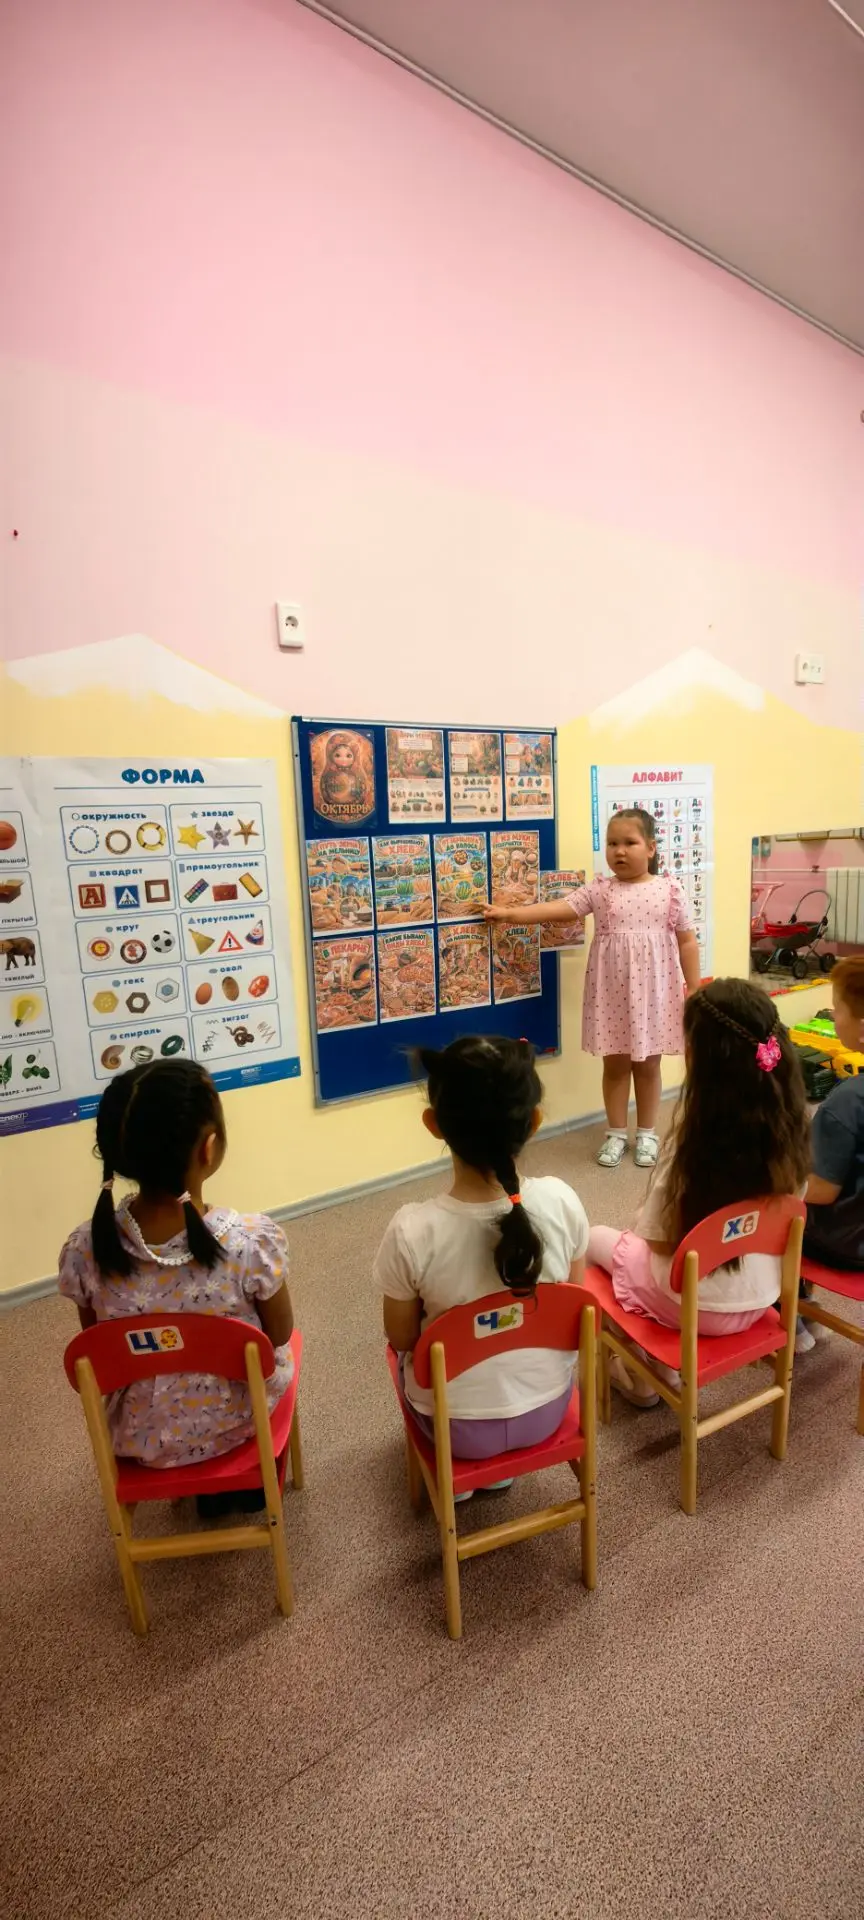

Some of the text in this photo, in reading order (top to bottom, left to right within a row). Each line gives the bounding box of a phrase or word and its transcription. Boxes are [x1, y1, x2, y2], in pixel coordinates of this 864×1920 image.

[121, 768, 205, 784] ФОРМА
[632, 771, 683, 783] АЛФАВИТ
[201, 809, 234, 818] звезда
[321, 803, 369, 814] ОКТЯБРЬ
[82, 812, 146, 821] окружность
[186, 860, 260, 872] прямоугольник
[99, 867, 143, 878] квадрат
[196, 913, 255, 925] треугольник
[116, 923, 139, 933] круг
[220, 964, 243, 973] овал
[123, 977, 145, 985] гекс
[221, 1013, 249, 1023] зигзаг
[119, 1027, 161, 1040] спираль
[477, 1312, 498, 1330] Ч
[129, 1331, 159, 1352] Ц
